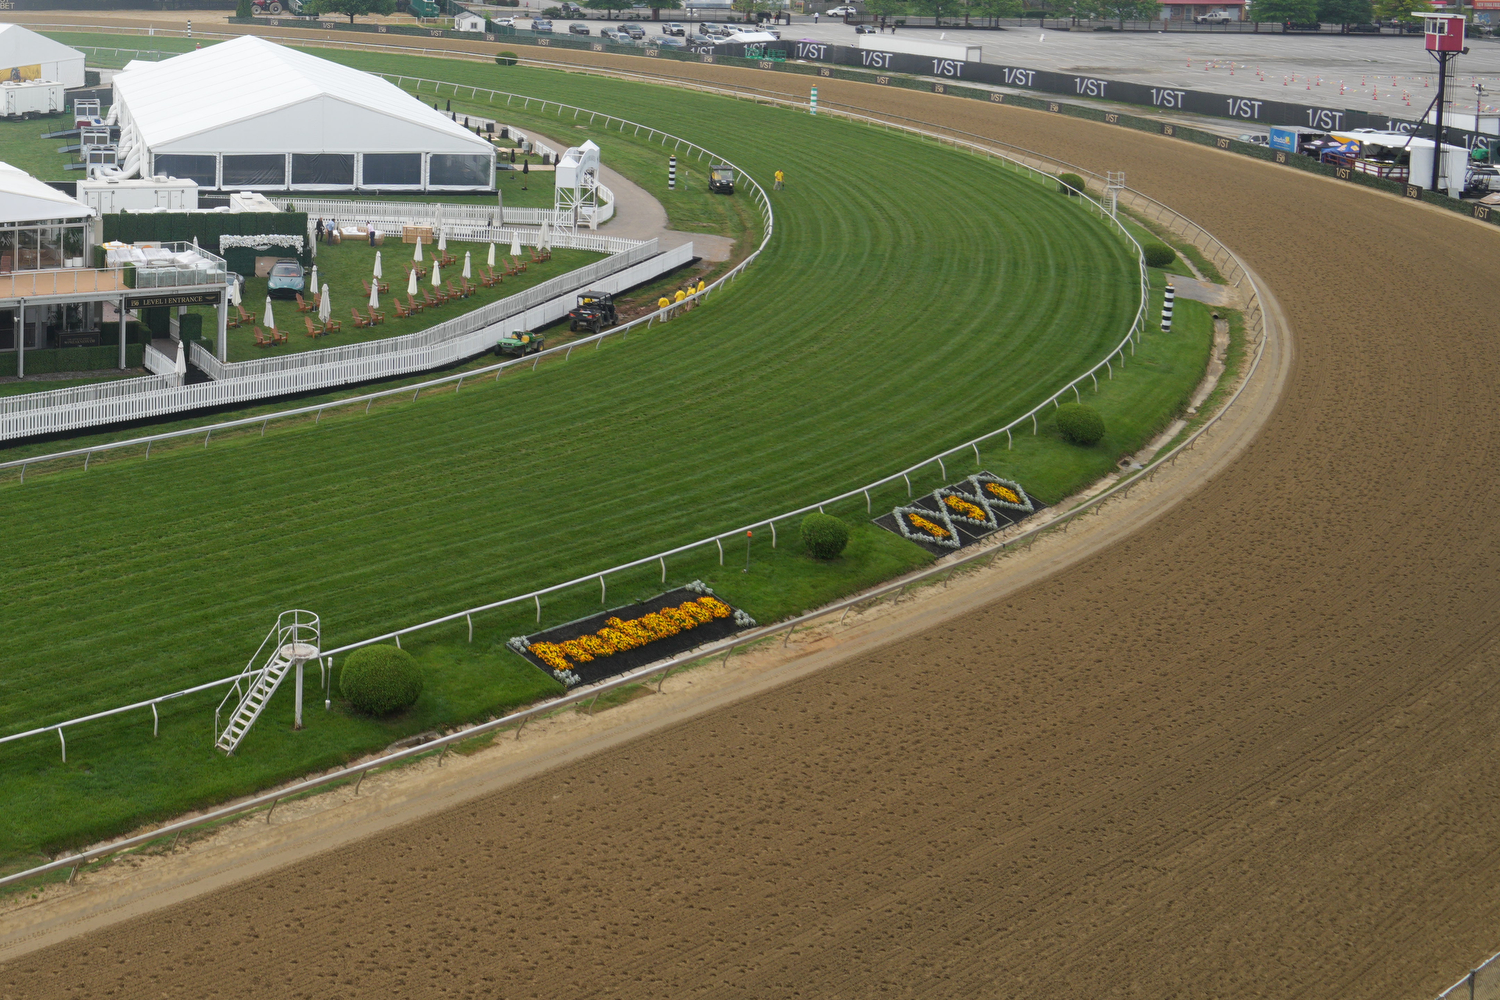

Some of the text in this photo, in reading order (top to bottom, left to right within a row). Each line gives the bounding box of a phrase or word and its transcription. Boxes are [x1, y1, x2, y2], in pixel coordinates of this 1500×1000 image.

[0, 2, 15, 10] BET
[646, 49, 658, 57] 1/ST
[797, 43, 827, 60] 1/ST
[759, 61, 773, 69] 1/ST
[860, 50, 894, 68] 1/ST
[931, 58, 965, 77] 1/ST
[876, 76, 890, 85] 1/ST
[1002, 67, 1036, 87] 1/ST
[1074, 77, 1108, 97] 1/ST
[990, 93, 1004, 102] 1/ST
[1150, 88, 1186, 109] 1/ST
[1226, 98, 1263, 119] 1/ST
[1105, 113, 1119, 123] 1/ST
[1306, 108, 1344, 131] 1/ST
[1217, 137, 1230, 148] 1/ST
[1336, 166, 1351, 180] 1/ST
[1406, 186, 1418, 198] 150
[1474, 205, 1489, 220] 1/ST
[143, 298, 164, 306] LEVEL
[168, 295, 203, 304] ENTRANCE
